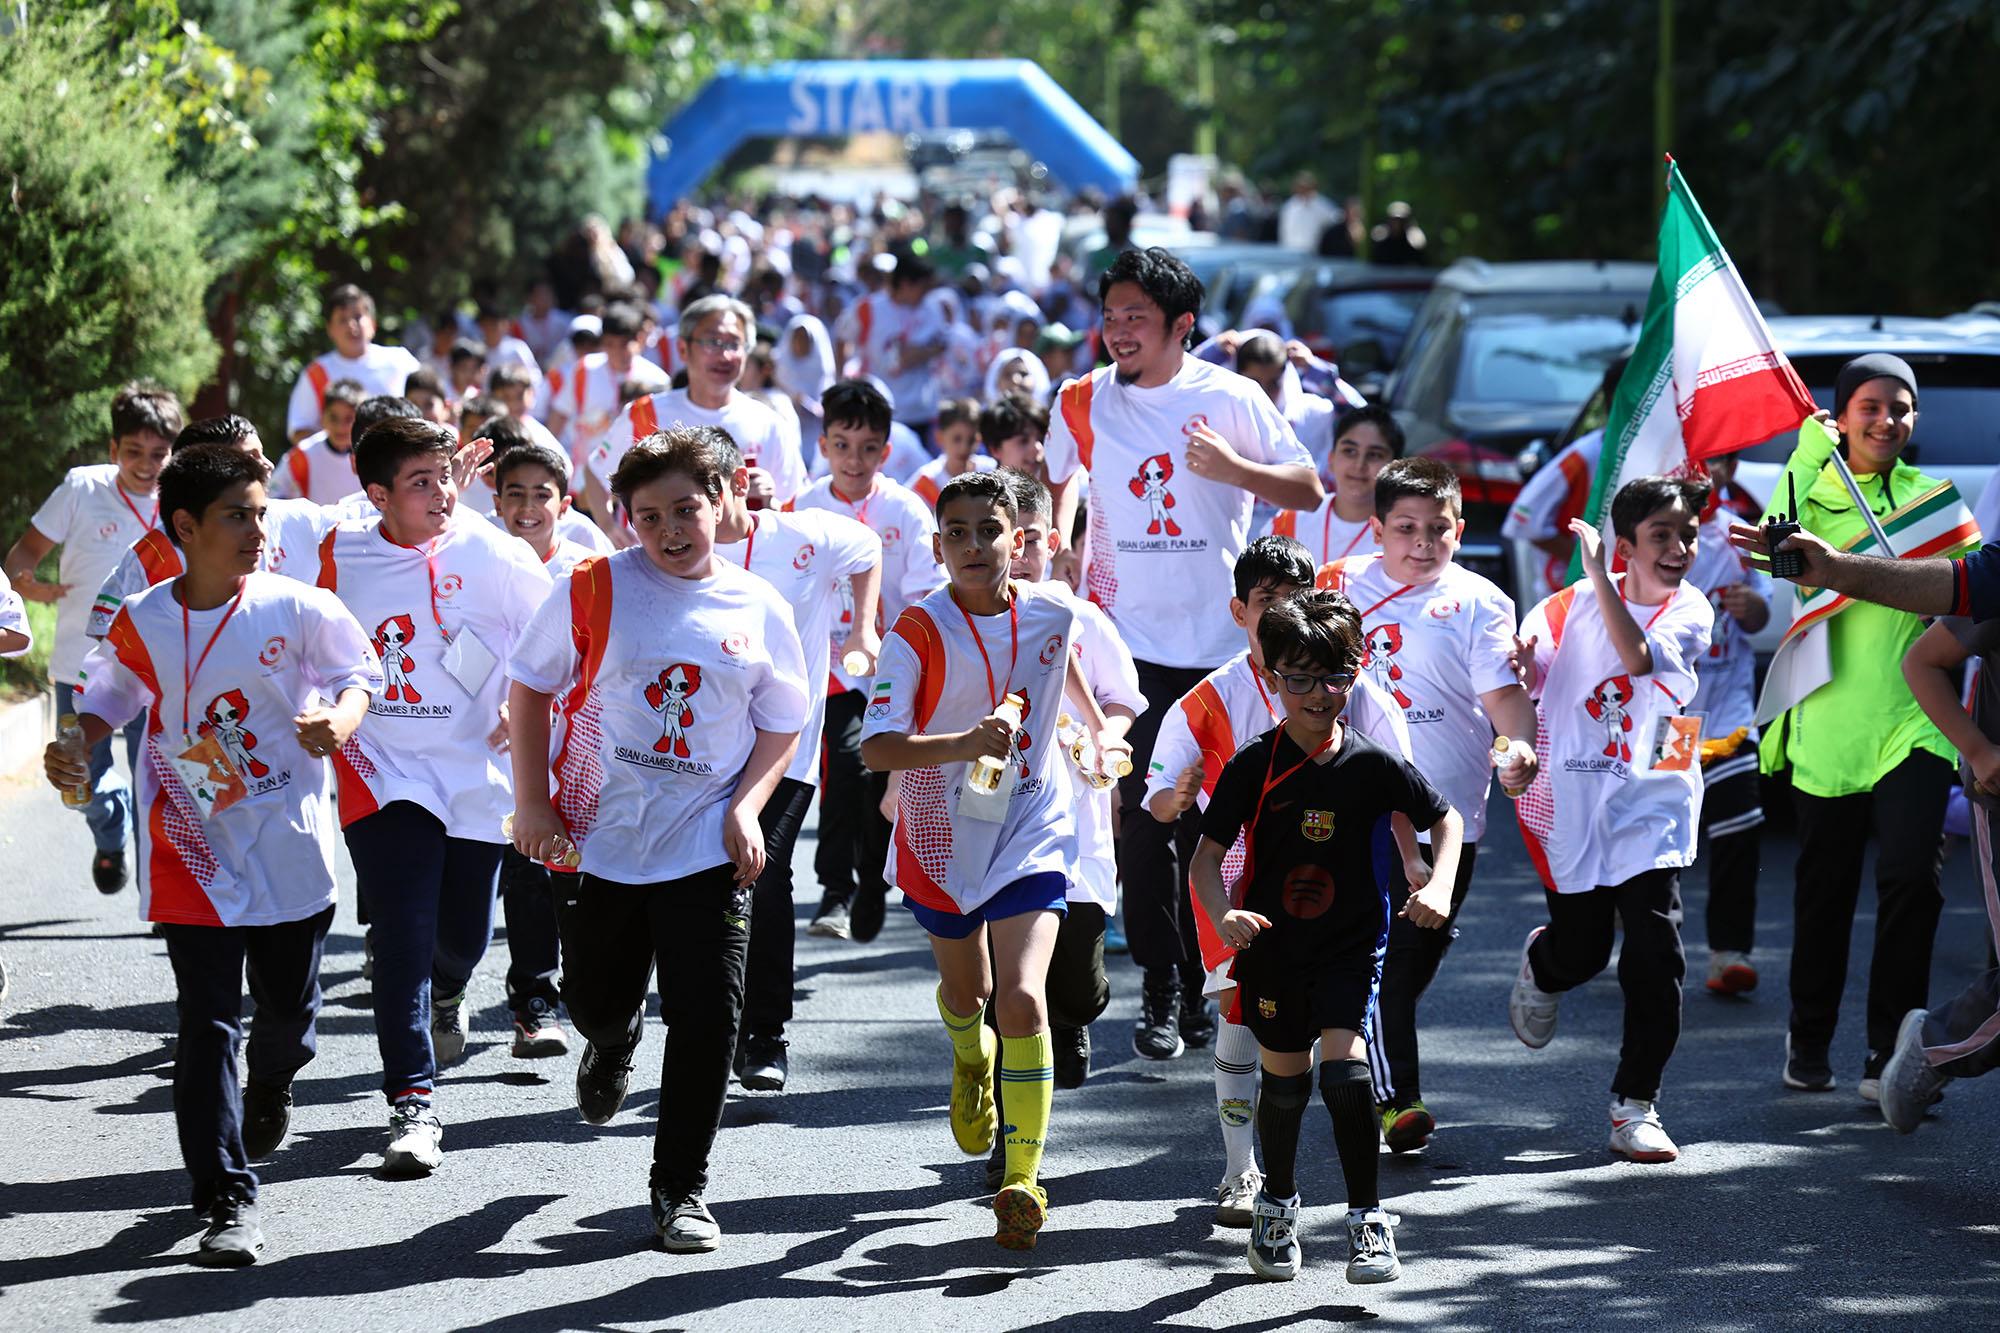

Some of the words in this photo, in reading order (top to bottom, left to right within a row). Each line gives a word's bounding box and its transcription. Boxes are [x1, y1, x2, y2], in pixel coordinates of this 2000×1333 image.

[787, 76, 956, 133] START
[1117, 540, 1138, 549] ASIAN
[1139, 540, 1168, 550] GAMES
[1170, 539, 1188, 549] FUN
[1190, 539, 1208, 548] RUN
[378, 704, 408, 715] GAMES
[410, 705, 430, 715] FUN
[432, 705, 452, 715] RUN
[1407, 711, 1426, 721] FUN
[1428, 708, 1445, 720] RUN
[614, 746, 641, 761] ASIAN
[640, 754, 675, 769] GAMES
[1564, 759, 1589, 769] ASIAN
[1589, 760, 1614, 770] GAME
